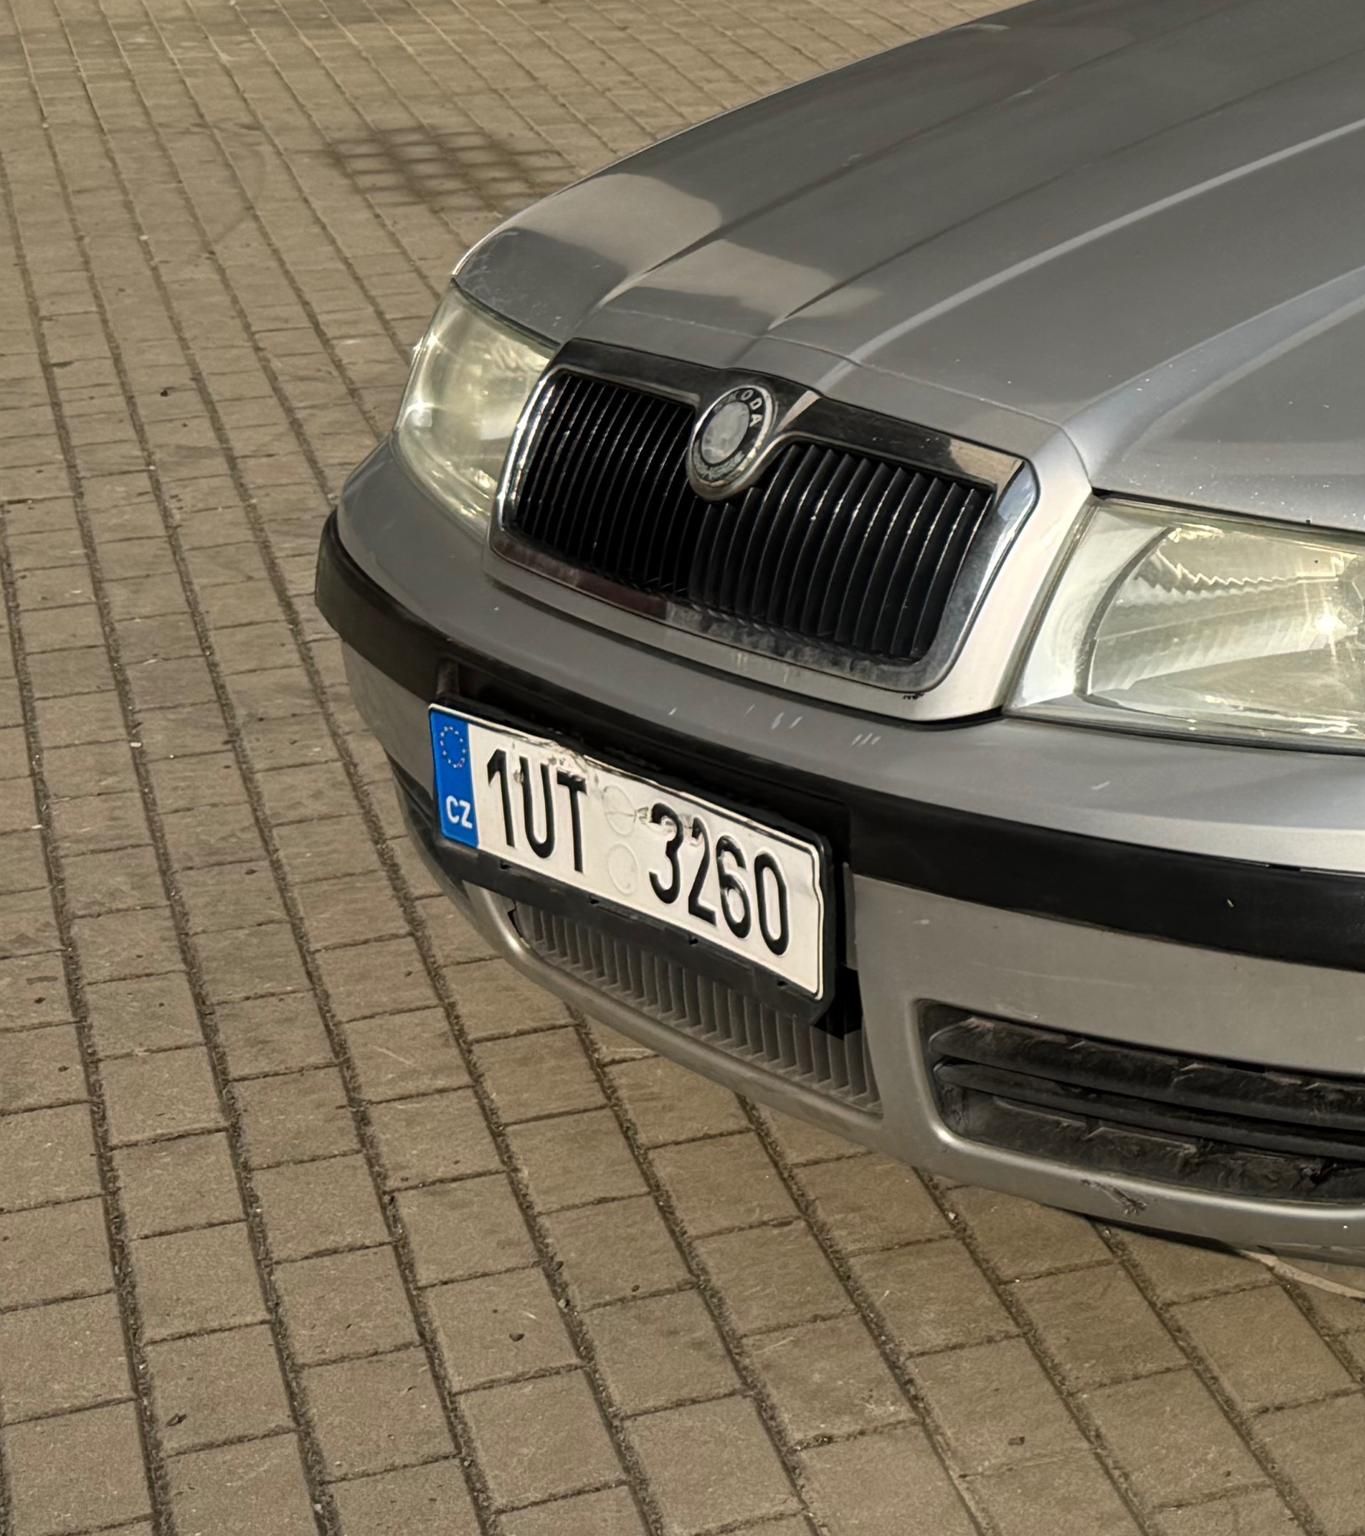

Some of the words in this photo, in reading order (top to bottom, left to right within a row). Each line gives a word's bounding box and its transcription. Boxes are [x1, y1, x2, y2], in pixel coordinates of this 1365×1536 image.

[445, 794, 473, 830] CZ
[486, 747, 588, 874] 1UT
[648, 801, 791, 957] 3260
